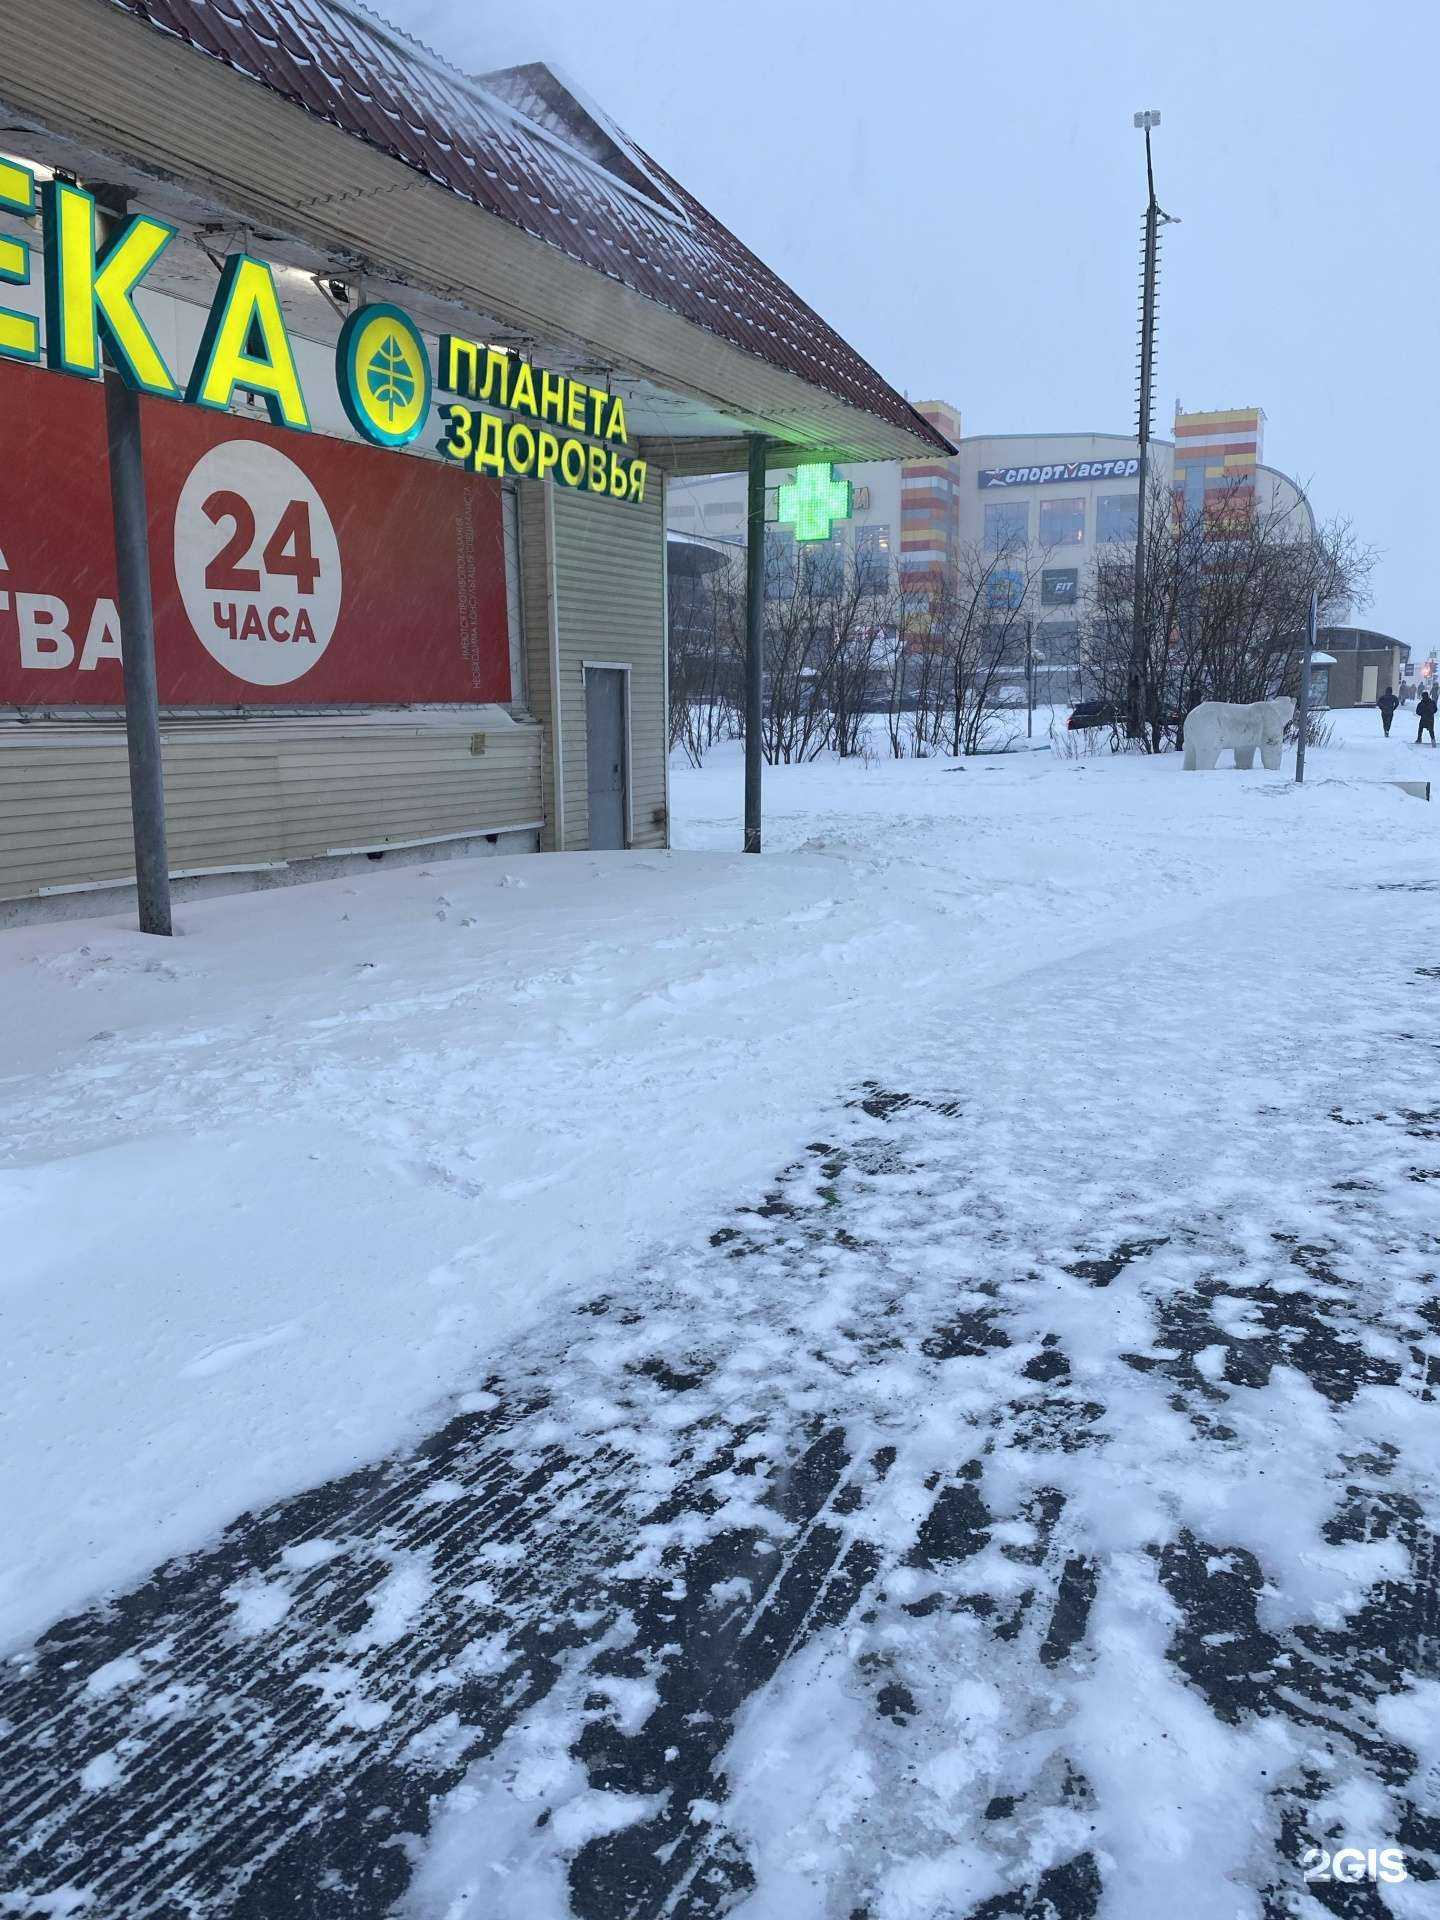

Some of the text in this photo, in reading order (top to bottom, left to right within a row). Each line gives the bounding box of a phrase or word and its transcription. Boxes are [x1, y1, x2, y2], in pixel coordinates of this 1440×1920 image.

[440, 334, 628, 445] ПЛАНЕТА
[439, 404, 647, 504] ЗДОРОВЬЯ
[201, 490, 321, 594] 24
[0, 590, 124, 671] ВА
[213, 602, 317, 644] ЧАСА
